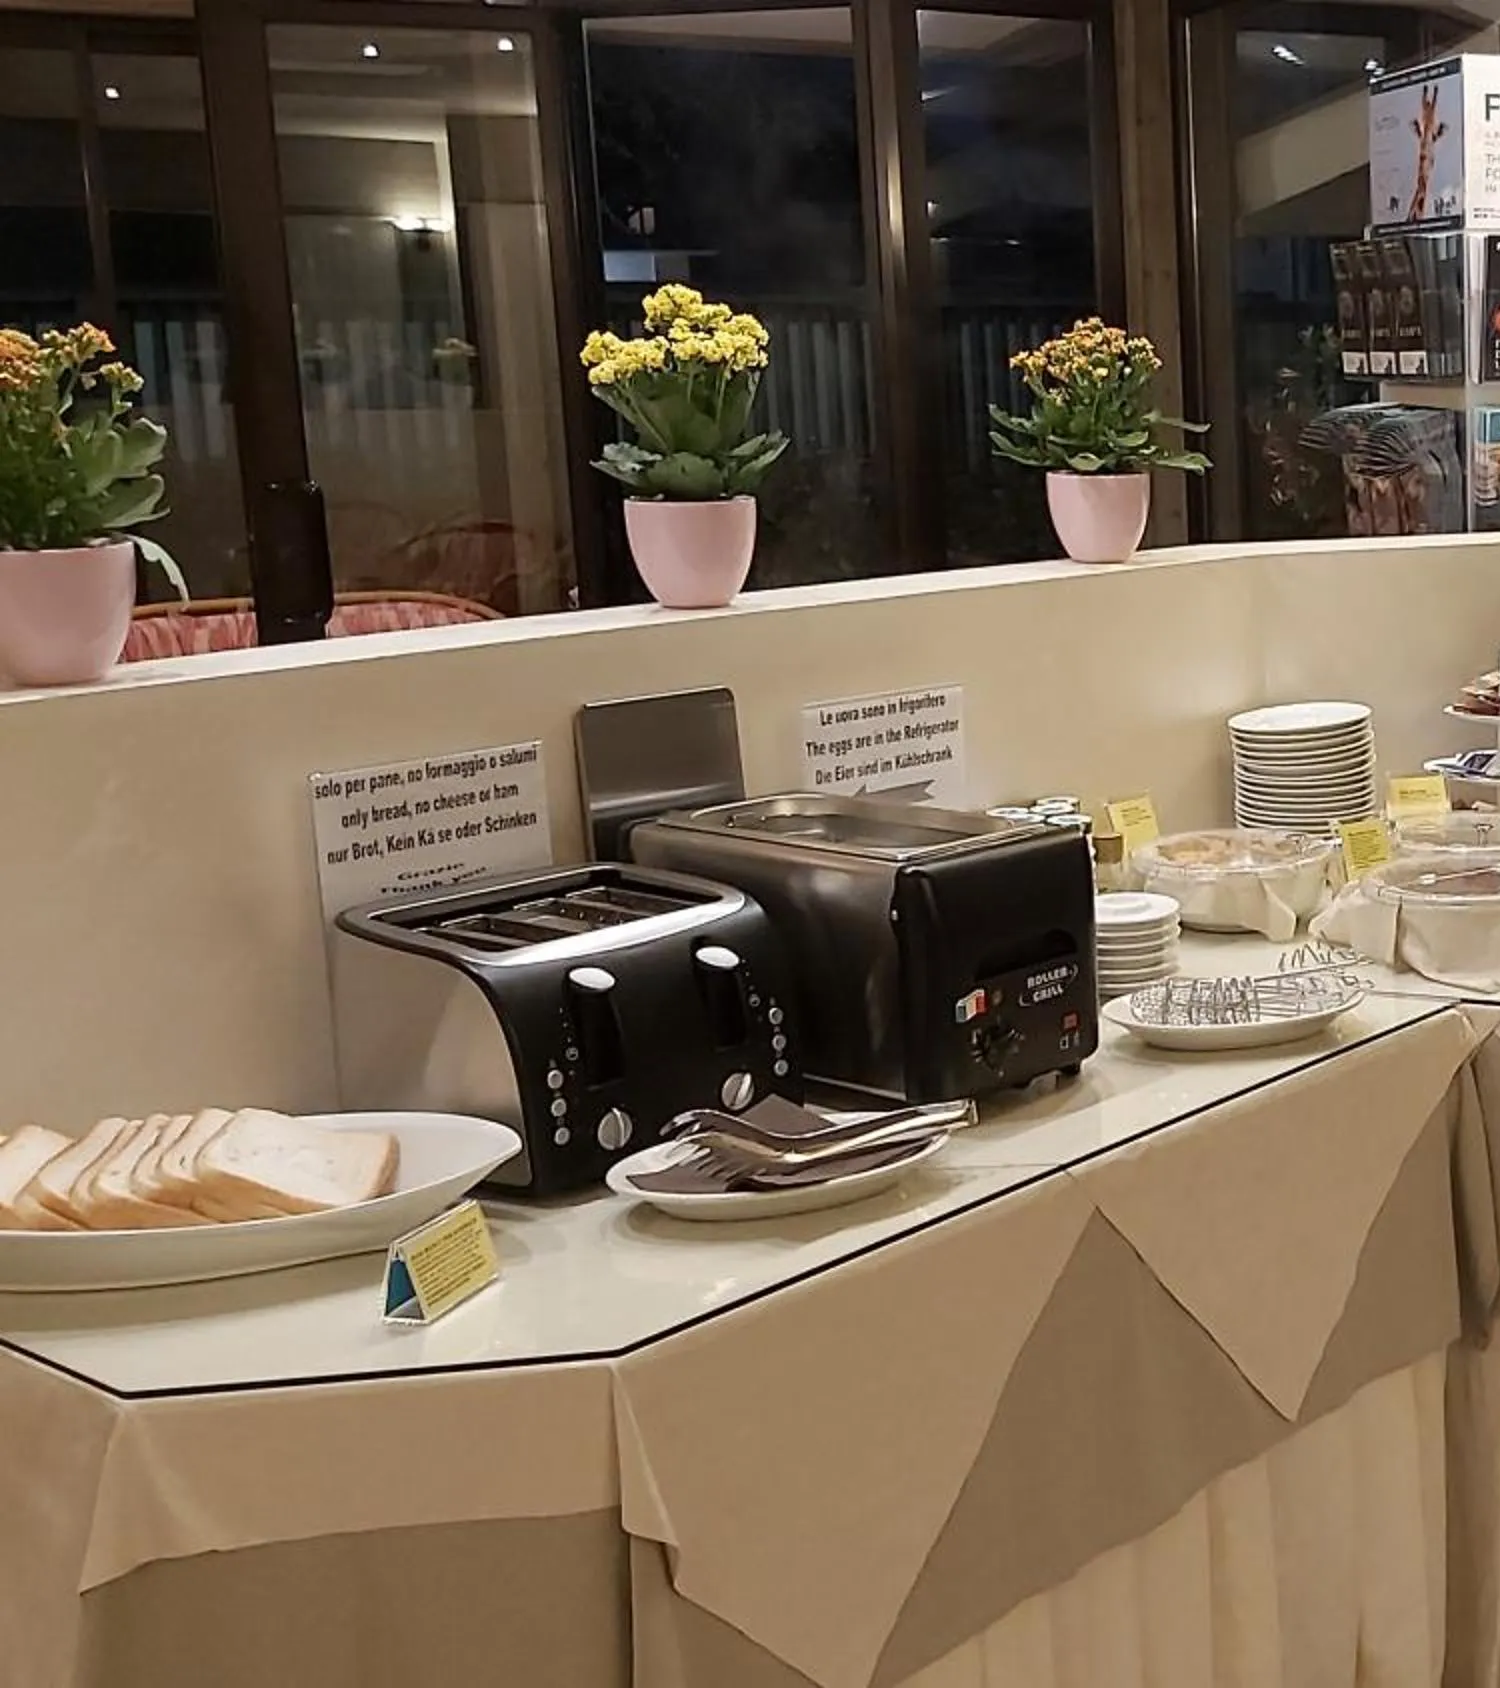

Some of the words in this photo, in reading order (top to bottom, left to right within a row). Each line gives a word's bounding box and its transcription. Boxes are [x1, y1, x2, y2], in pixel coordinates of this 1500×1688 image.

[819, 709, 833, 726] Le
[835, 708, 859, 724] uova
[861, 703, 885, 719] sono
[887, 700, 897, 715] in
[899, 693, 946, 715] frigorifero
[806, 740, 826, 757] The
[828, 737, 853, 757] eggs
[855, 734, 872, 749] are
[874, 731, 884, 745] in
[885, 727, 902, 743] the
[903, 719, 959, 740] Refrigerator
[315, 779, 341, 799] solo
[345, 777, 366, 799] per
[407, 768, 423, 783] no
[425, 755, 487, 779] formaggio
[489, 756, 497, 769] o
[499, 747, 537, 767] salumi
[815, 768, 832, 785] Die
[835, 764, 855, 782] Eier
[857, 759, 878, 778] sind
[879, 757, 893, 772] im
[895, 745, 953, 770] Kühlschrank
[341, 808, 368, 830] only
[371, 800, 412, 823] bread,
[415, 800, 430, 815] no
[433, 790, 477, 811] cheese
[479, 788, 491, 803] or
[493, 783, 519, 800] ham
[327, 847, 349, 865] nur
[351, 839, 384, 860] Brot,
[386, 834, 415, 854] Kein
[437, 827, 452, 843] se
[455, 820, 482, 839] oder
[484, 810, 537, 833] Schinken
[1027, 965, 1068, 989] ROLLER
[1033, 983, 1065, 1003] GRILL
